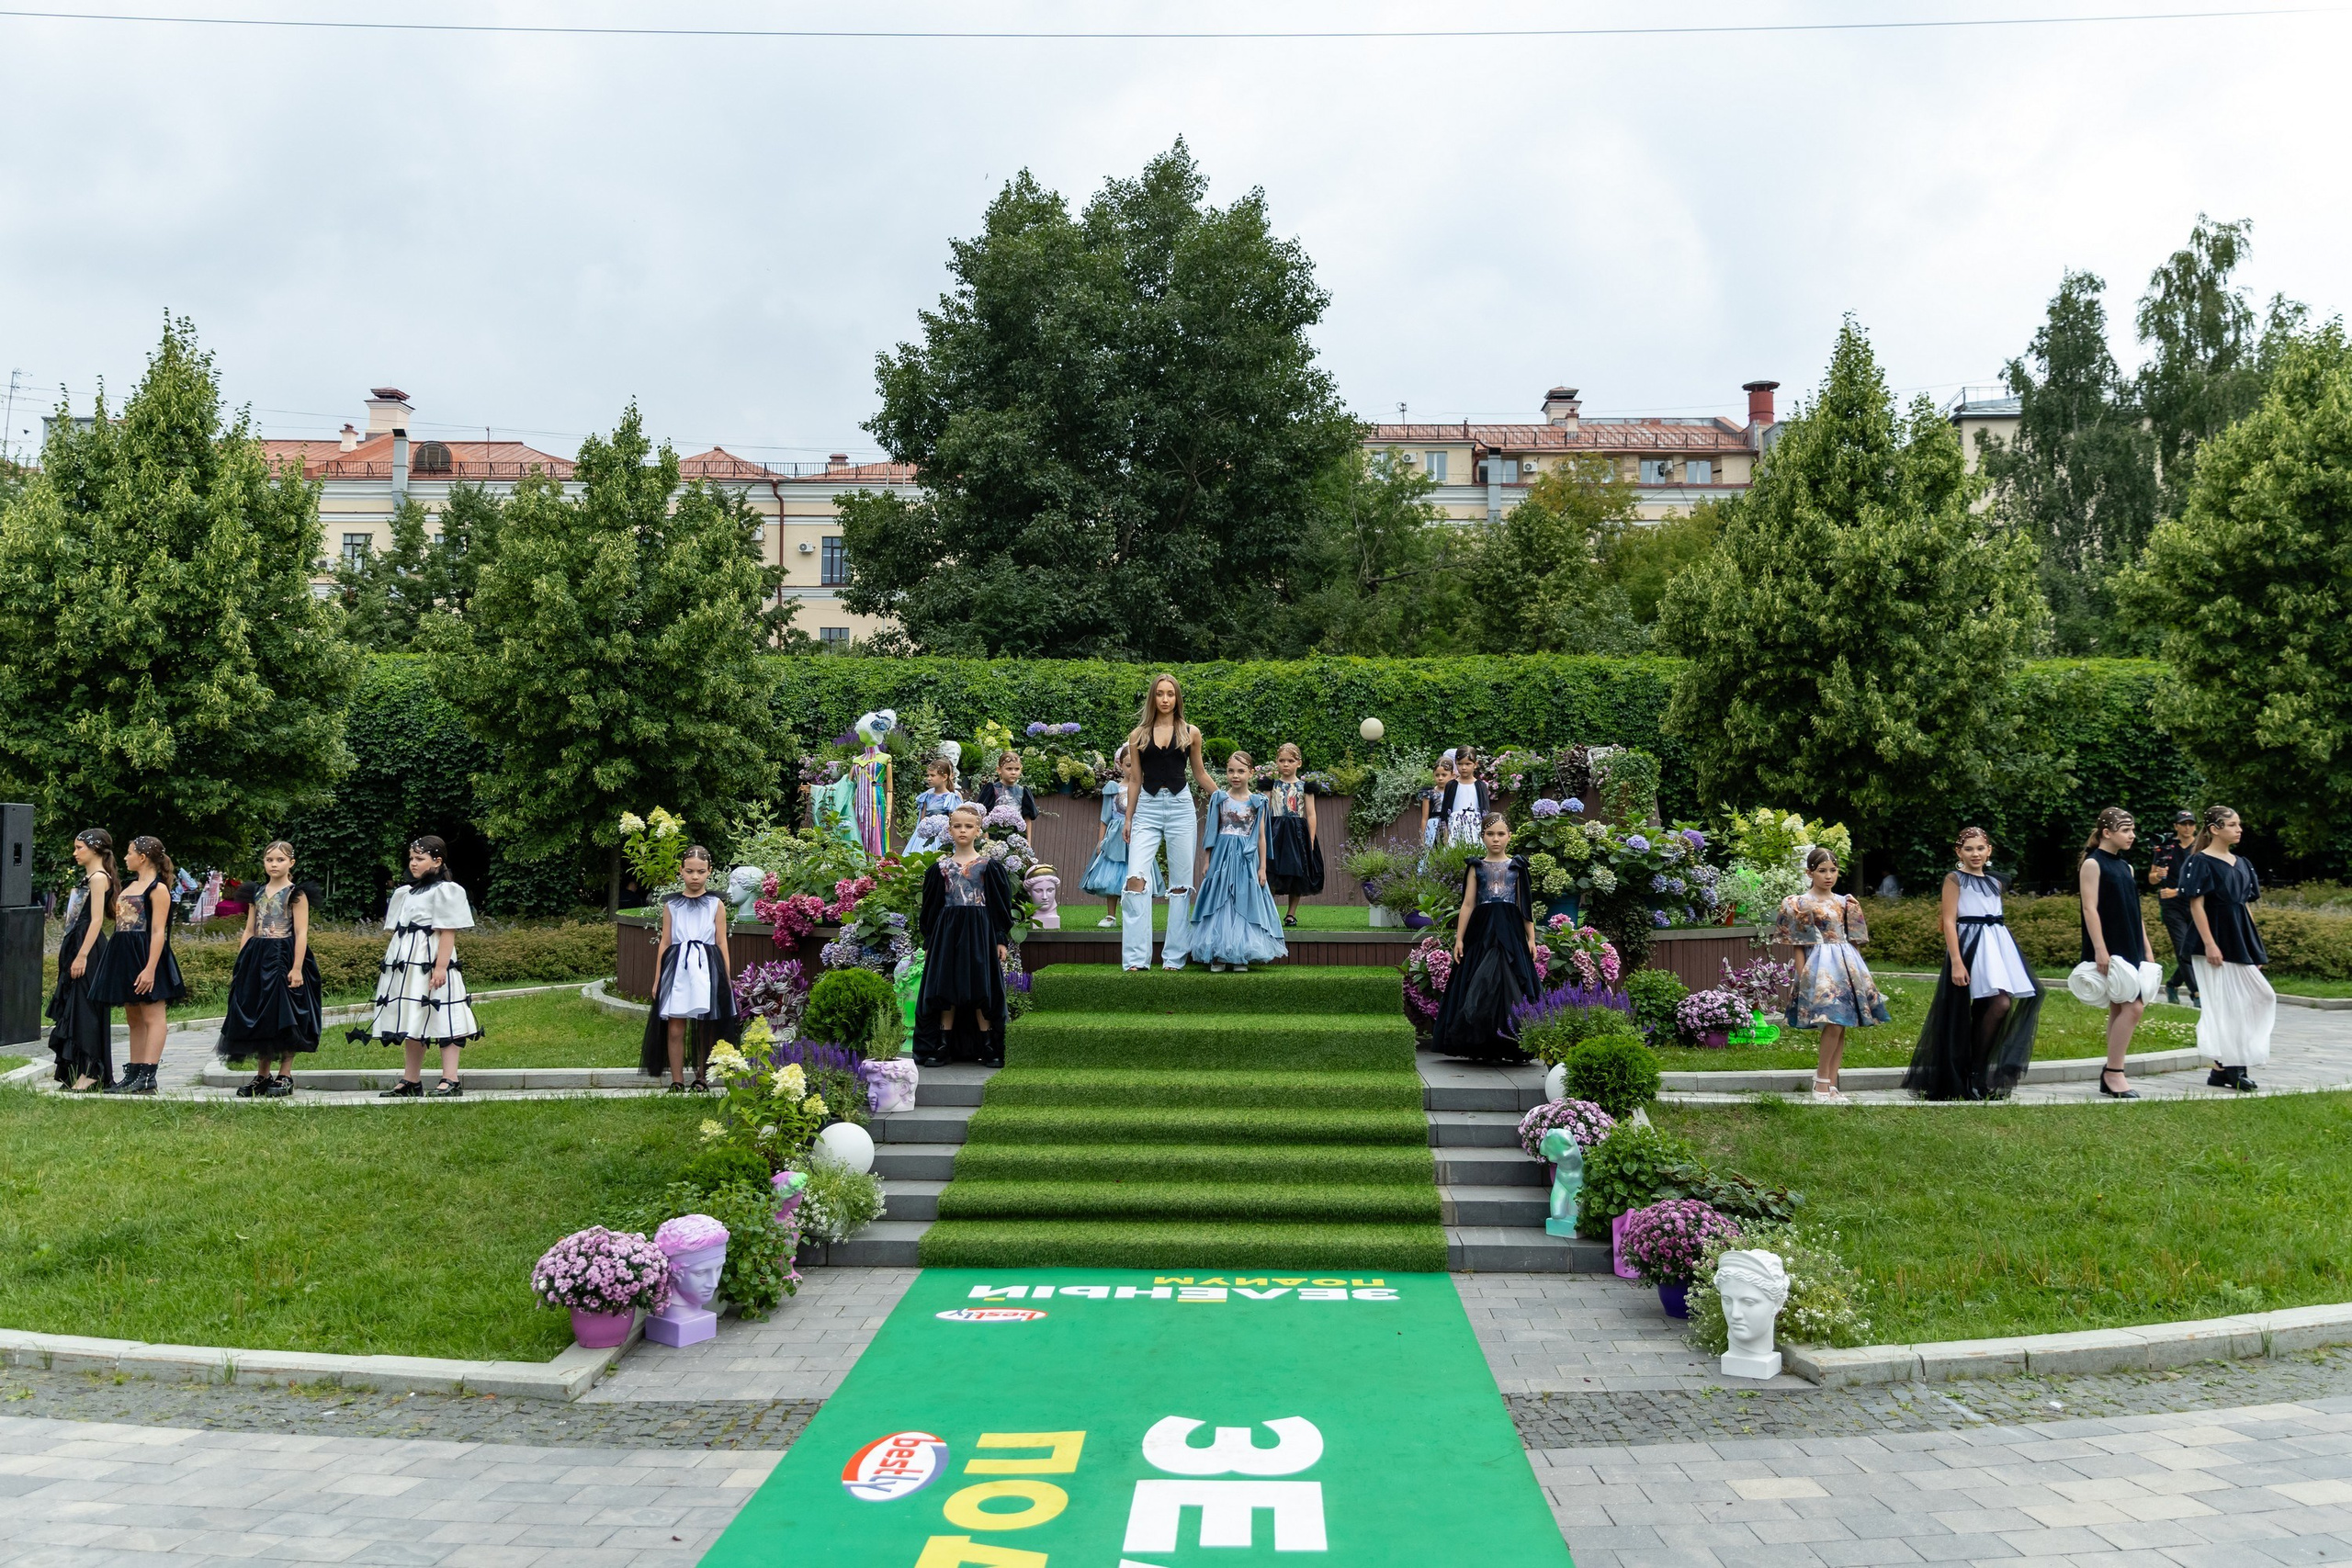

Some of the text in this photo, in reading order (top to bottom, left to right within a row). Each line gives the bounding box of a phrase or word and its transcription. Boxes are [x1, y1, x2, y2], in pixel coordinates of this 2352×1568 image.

[1153, 1276, 1385, 1287] ПОДИУМ
[949, 1308, 1037, 1321] bestly
[842, 1436, 946, 1494] bestly
[1118, 1415, 1329, 1568] ЗЕ
